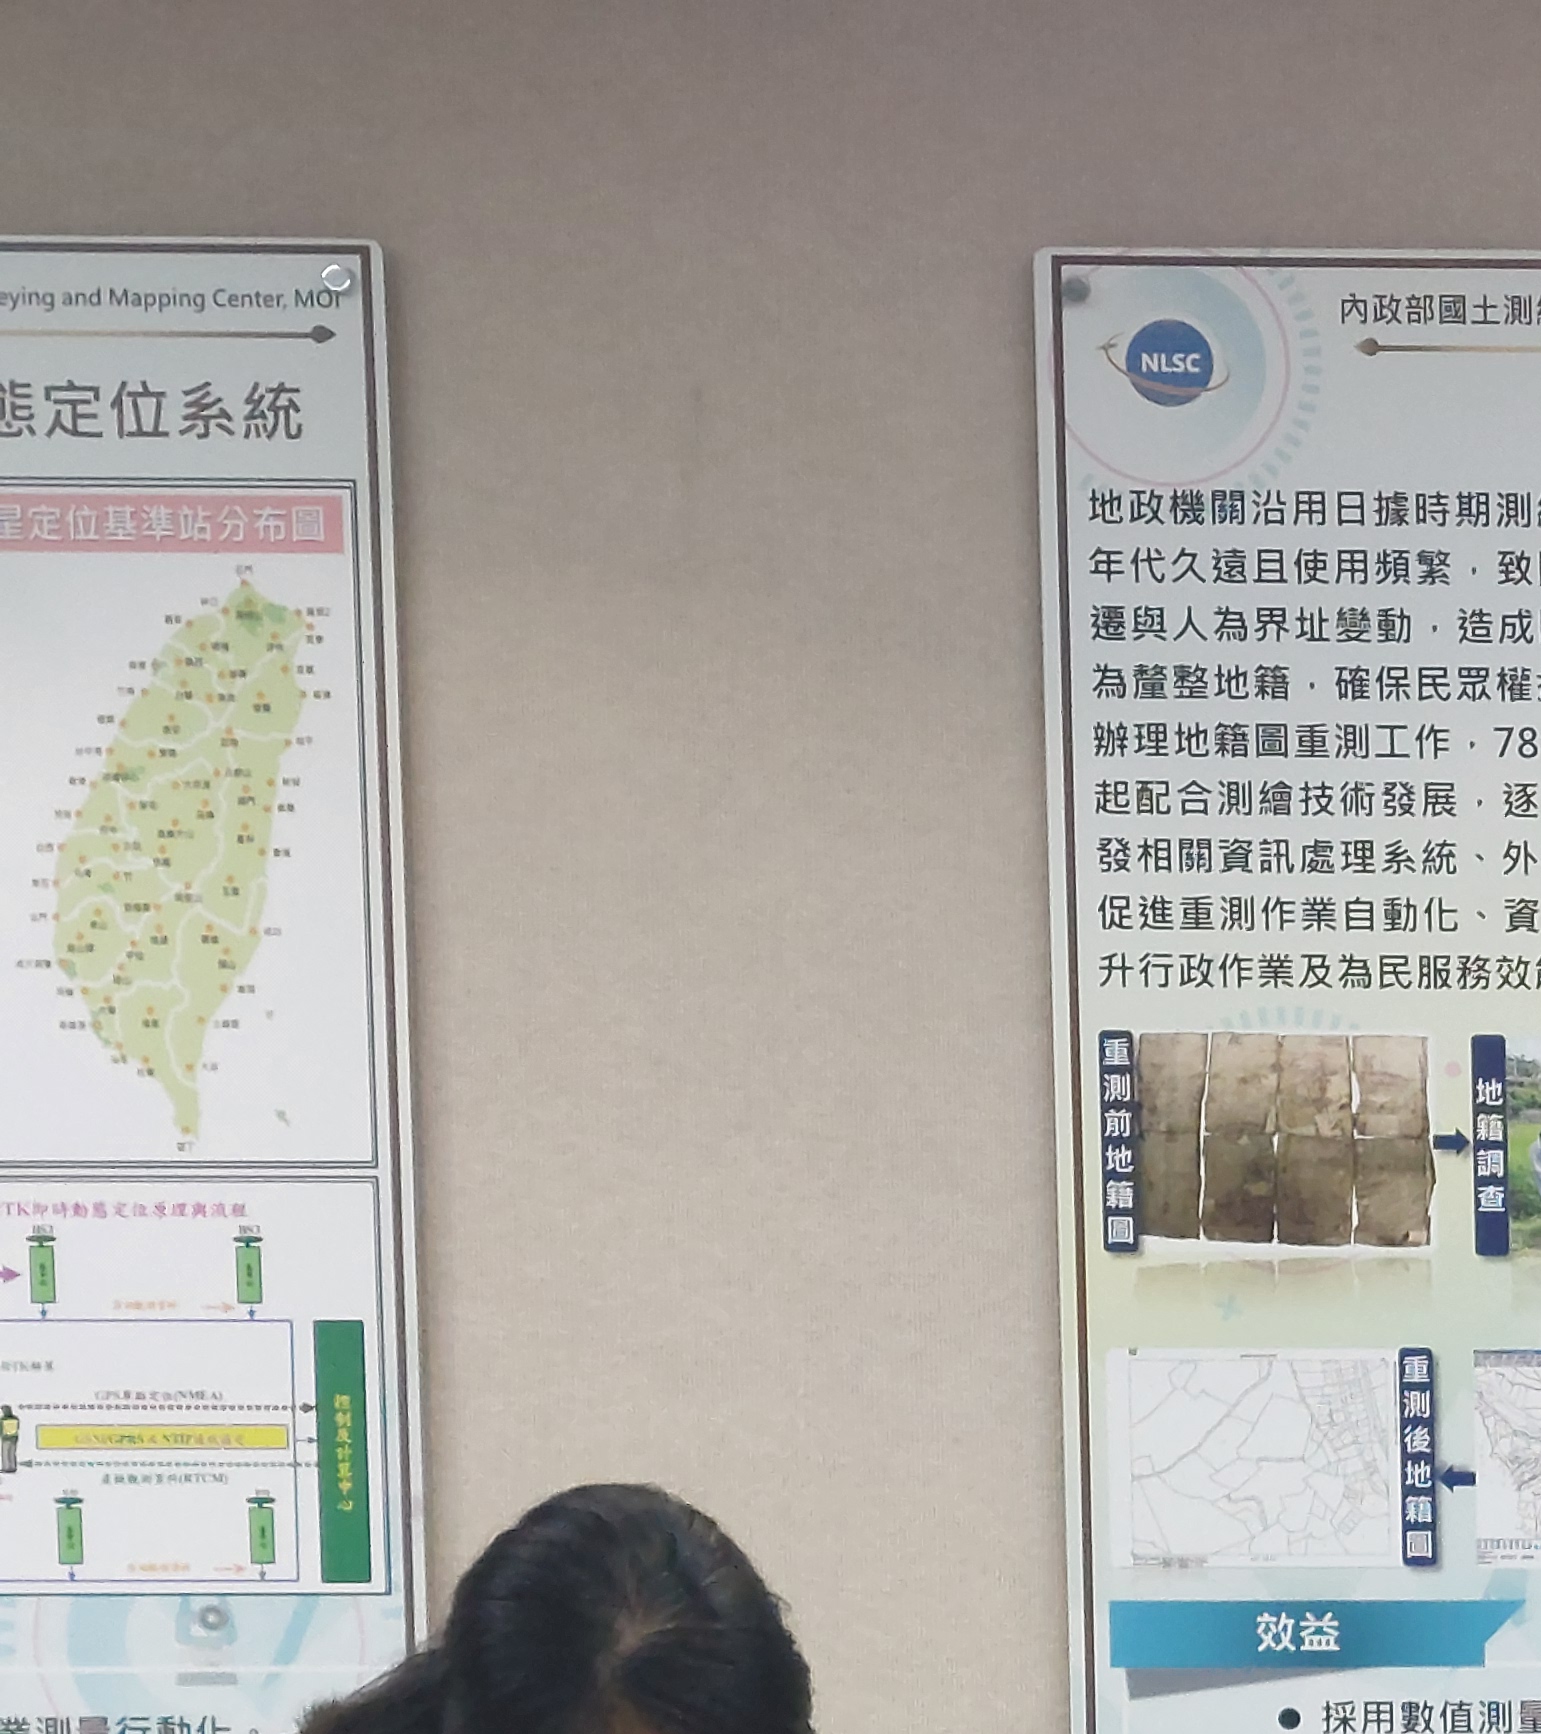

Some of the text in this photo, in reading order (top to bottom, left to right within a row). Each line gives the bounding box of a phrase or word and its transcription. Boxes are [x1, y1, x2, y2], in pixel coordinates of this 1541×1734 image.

[61, 286, 102, 307] and
[109, 287, 206, 314] Mapping
[212, 288, 287, 310] Center,
[294, 289, 341, 308] MOI
[1141, 352, 1202, 373] NLSC
[1102, 1037, 1135, 1246] 重測前地籍圖
[1476, 1077, 1506, 1213] 地籍調查
[1402, 1355, 1433, 1560] 重測後地籍圖
[1256, 1611, 1341, 1653] 效益
